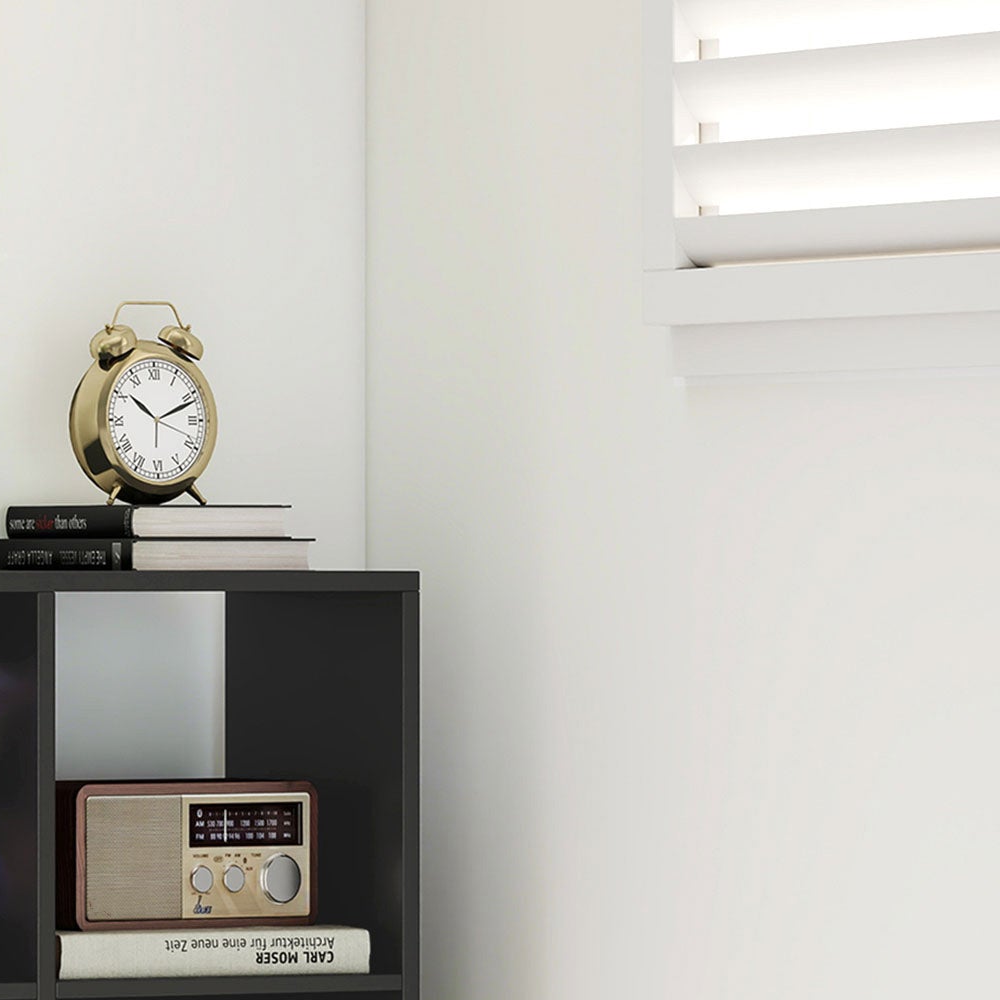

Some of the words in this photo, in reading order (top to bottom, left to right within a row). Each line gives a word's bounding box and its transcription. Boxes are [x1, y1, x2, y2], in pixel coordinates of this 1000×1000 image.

[148, 369, 160, 380] XII
[130, 374, 141, 389] XI
[170, 376, 176, 386] I
[182, 393, 191, 402] II
[114, 415, 124, 426] IX
[188, 415, 198, 425] III
[120, 433, 133, 453] VIII
[133, 452, 145, 468] VII
[171, 453, 179, 465] V
[153, 460, 163, 471] VI
[165, 939, 188, 952] Zeit
[191, 939, 219, 949] neue
[222, 938, 247, 951] eine
[250, 938, 266, 951] für
[271, 937, 335, 950] Architektur
[256, 951, 298, 964] MOSER
[304, 951, 334, 963] CARL
